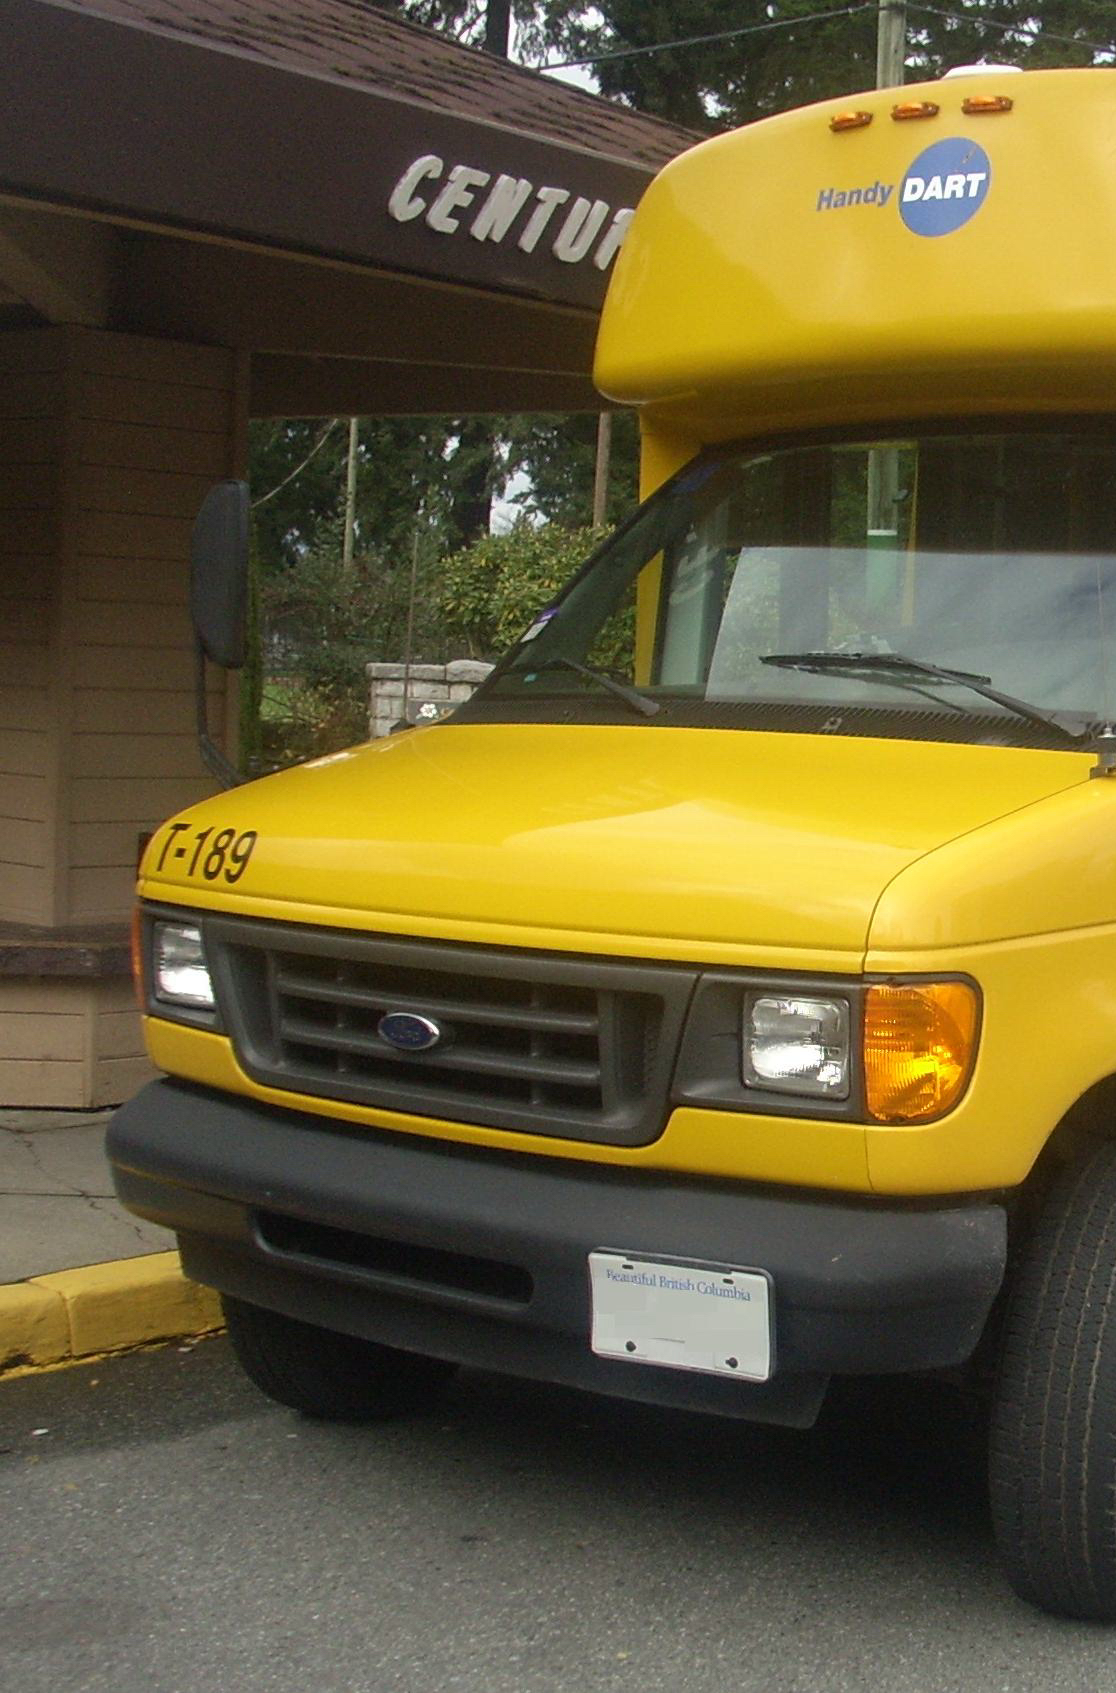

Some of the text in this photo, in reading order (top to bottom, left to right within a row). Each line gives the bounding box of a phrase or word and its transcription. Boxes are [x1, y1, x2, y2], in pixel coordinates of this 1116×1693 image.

[816, 172, 986, 212] Handy DART
[156, 823, 258, 883] T-189
[606, 1269, 751, 1302] Beautiful British Columbia
